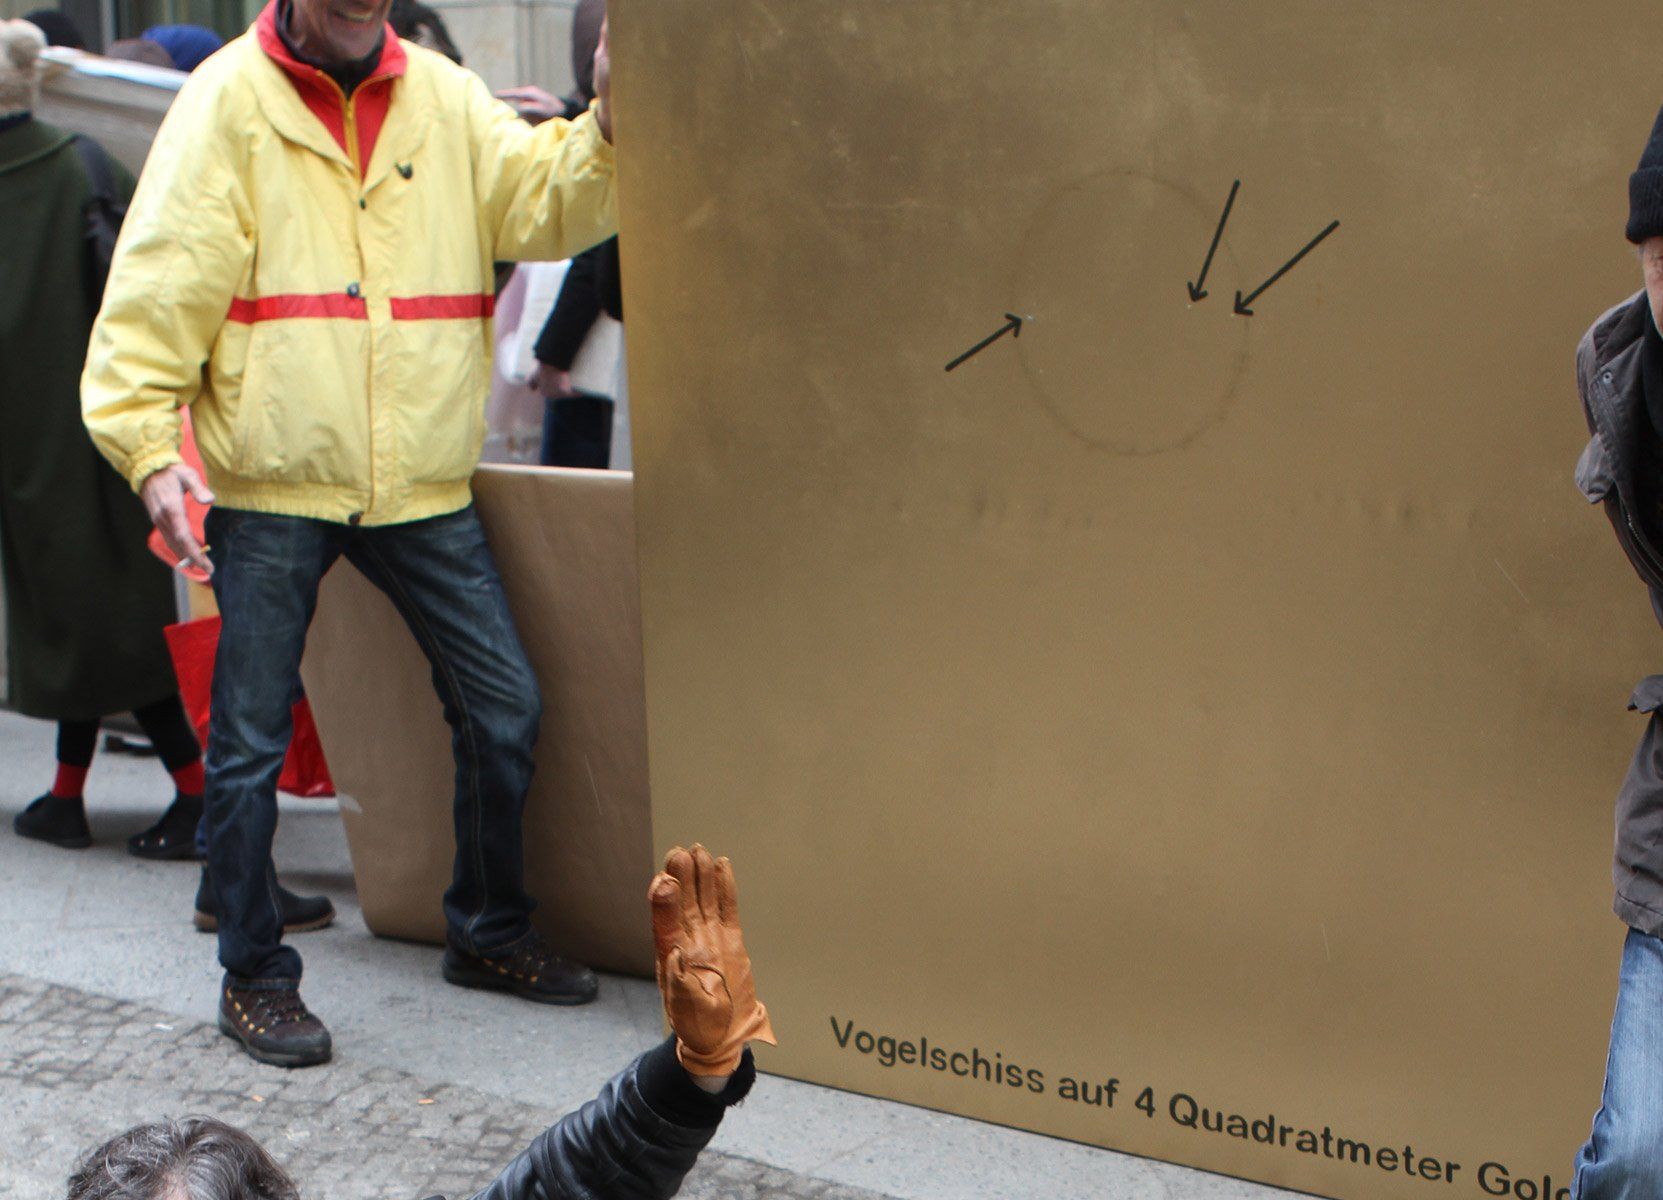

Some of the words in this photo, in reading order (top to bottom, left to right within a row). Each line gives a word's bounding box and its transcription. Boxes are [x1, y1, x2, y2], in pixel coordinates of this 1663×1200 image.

[830, 1016, 1045, 1094] Vogelschiss
[1058, 1078, 1120, 1108] auf
[1134, 1087, 1156, 1118] 4
[1169, 1093, 1463, 1184] Quadratmeter
